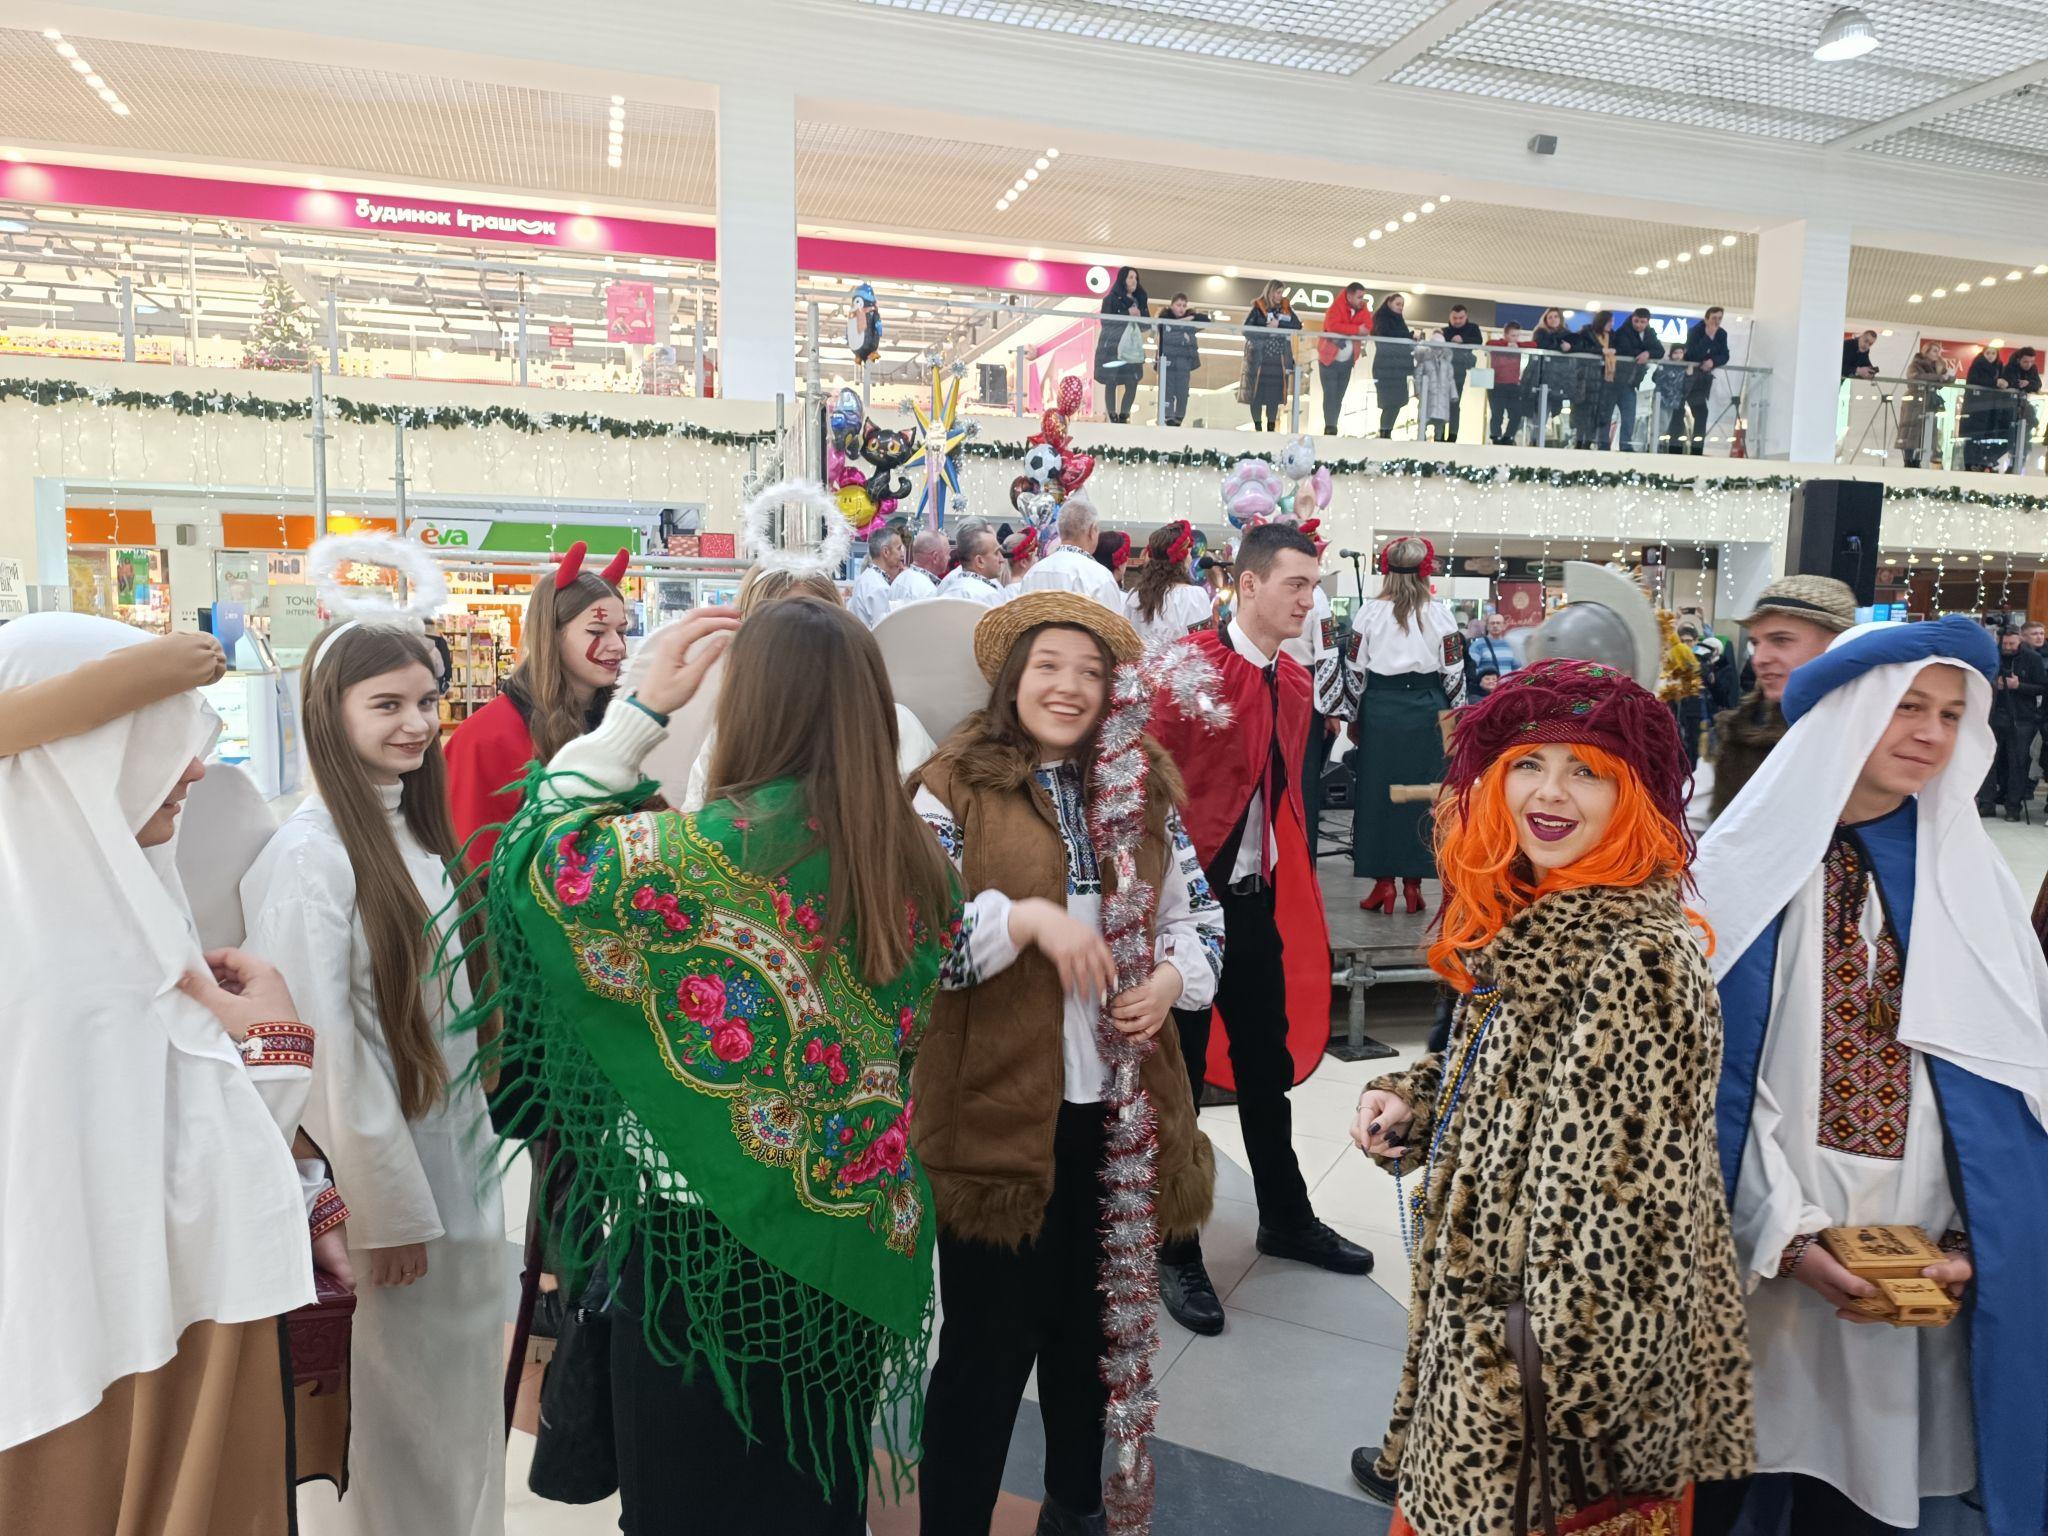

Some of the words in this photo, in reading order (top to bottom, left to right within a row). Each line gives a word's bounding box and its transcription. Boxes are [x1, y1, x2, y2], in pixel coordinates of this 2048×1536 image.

[456, 208, 557, 235] іграшок
[420, 524, 469, 546] eva
[285, 595, 319, 607] ТОЧК
